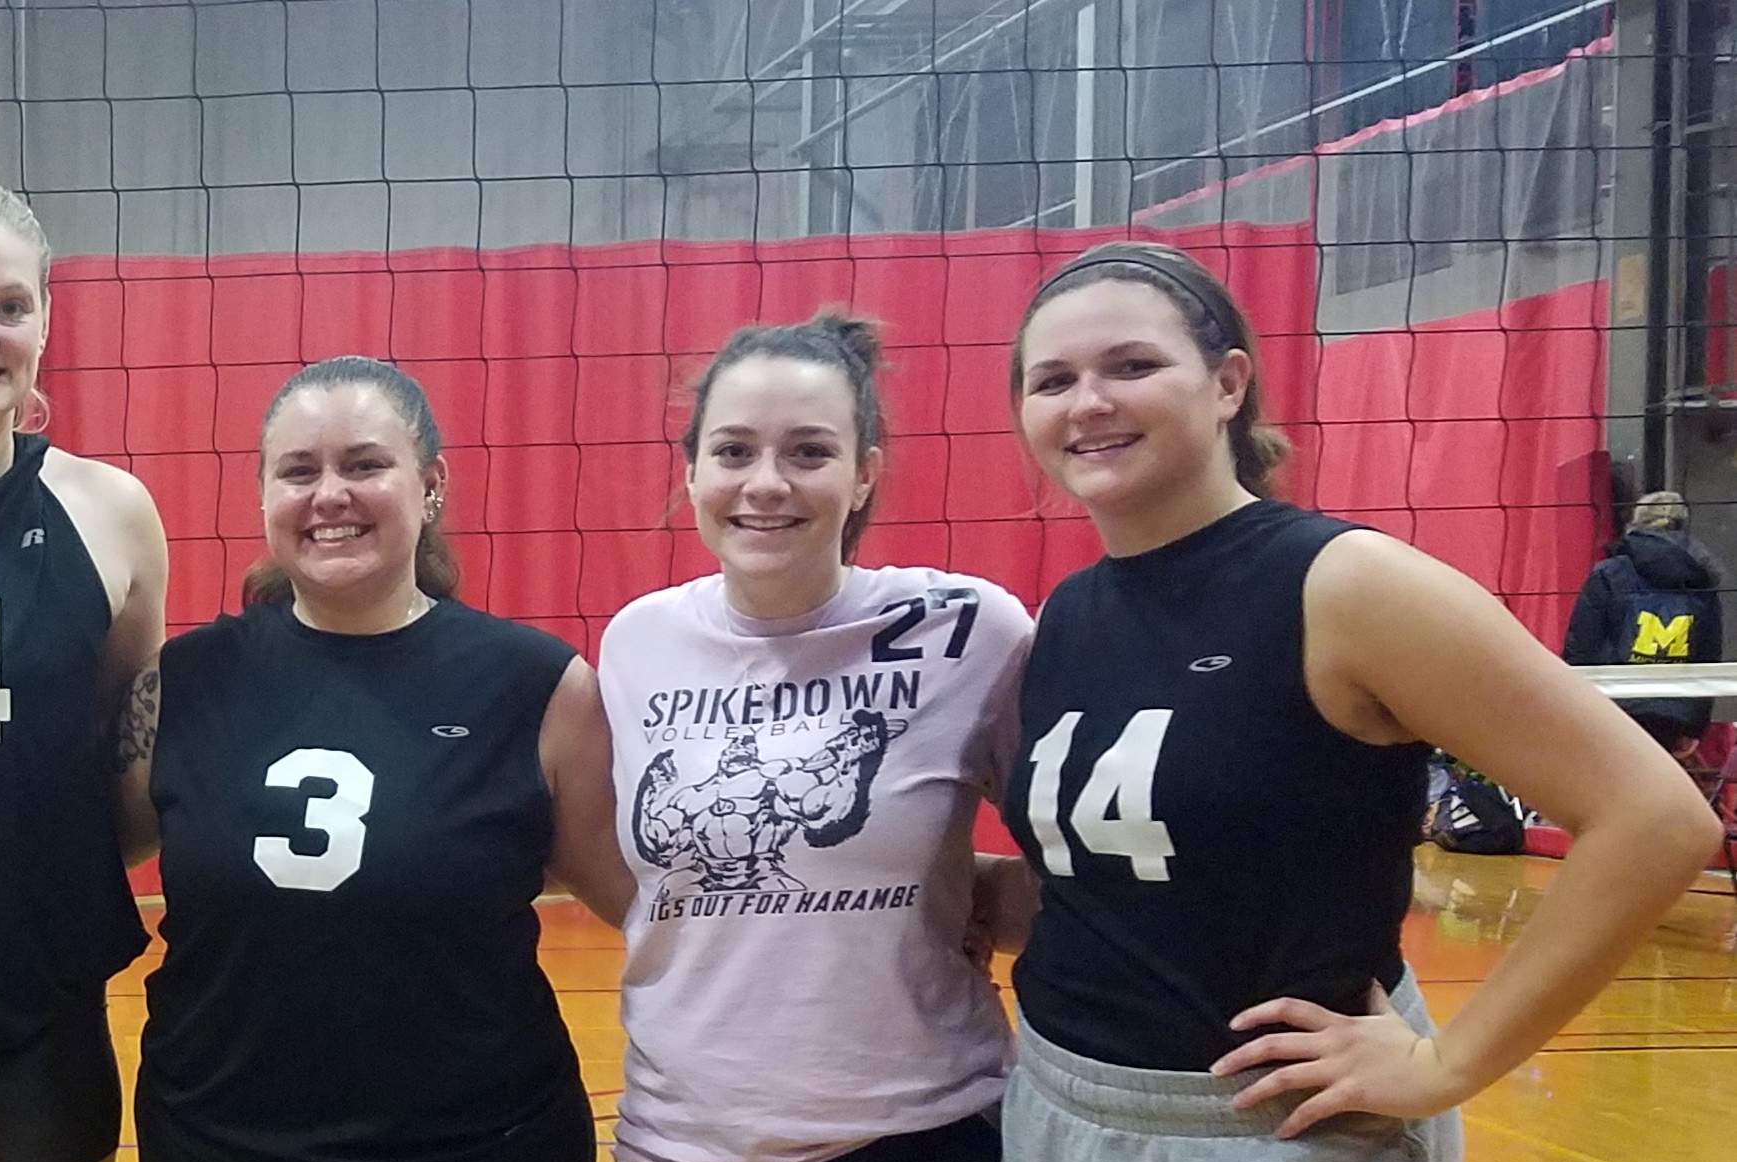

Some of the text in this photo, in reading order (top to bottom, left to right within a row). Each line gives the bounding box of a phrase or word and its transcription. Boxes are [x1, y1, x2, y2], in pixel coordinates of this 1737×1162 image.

[871, 588, 980, 662] 27
[1632, 610, 1694, 656] M
[643, 670, 920, 728] SPIKEDOWN
[644, 712, 852, 745] VOLLEYBALL
[253, 748, 375, 891] 3
[1027, 709, 1176, 881] 14
[648, 884, 919, 922] IGS OUT FOR HARAMBE
